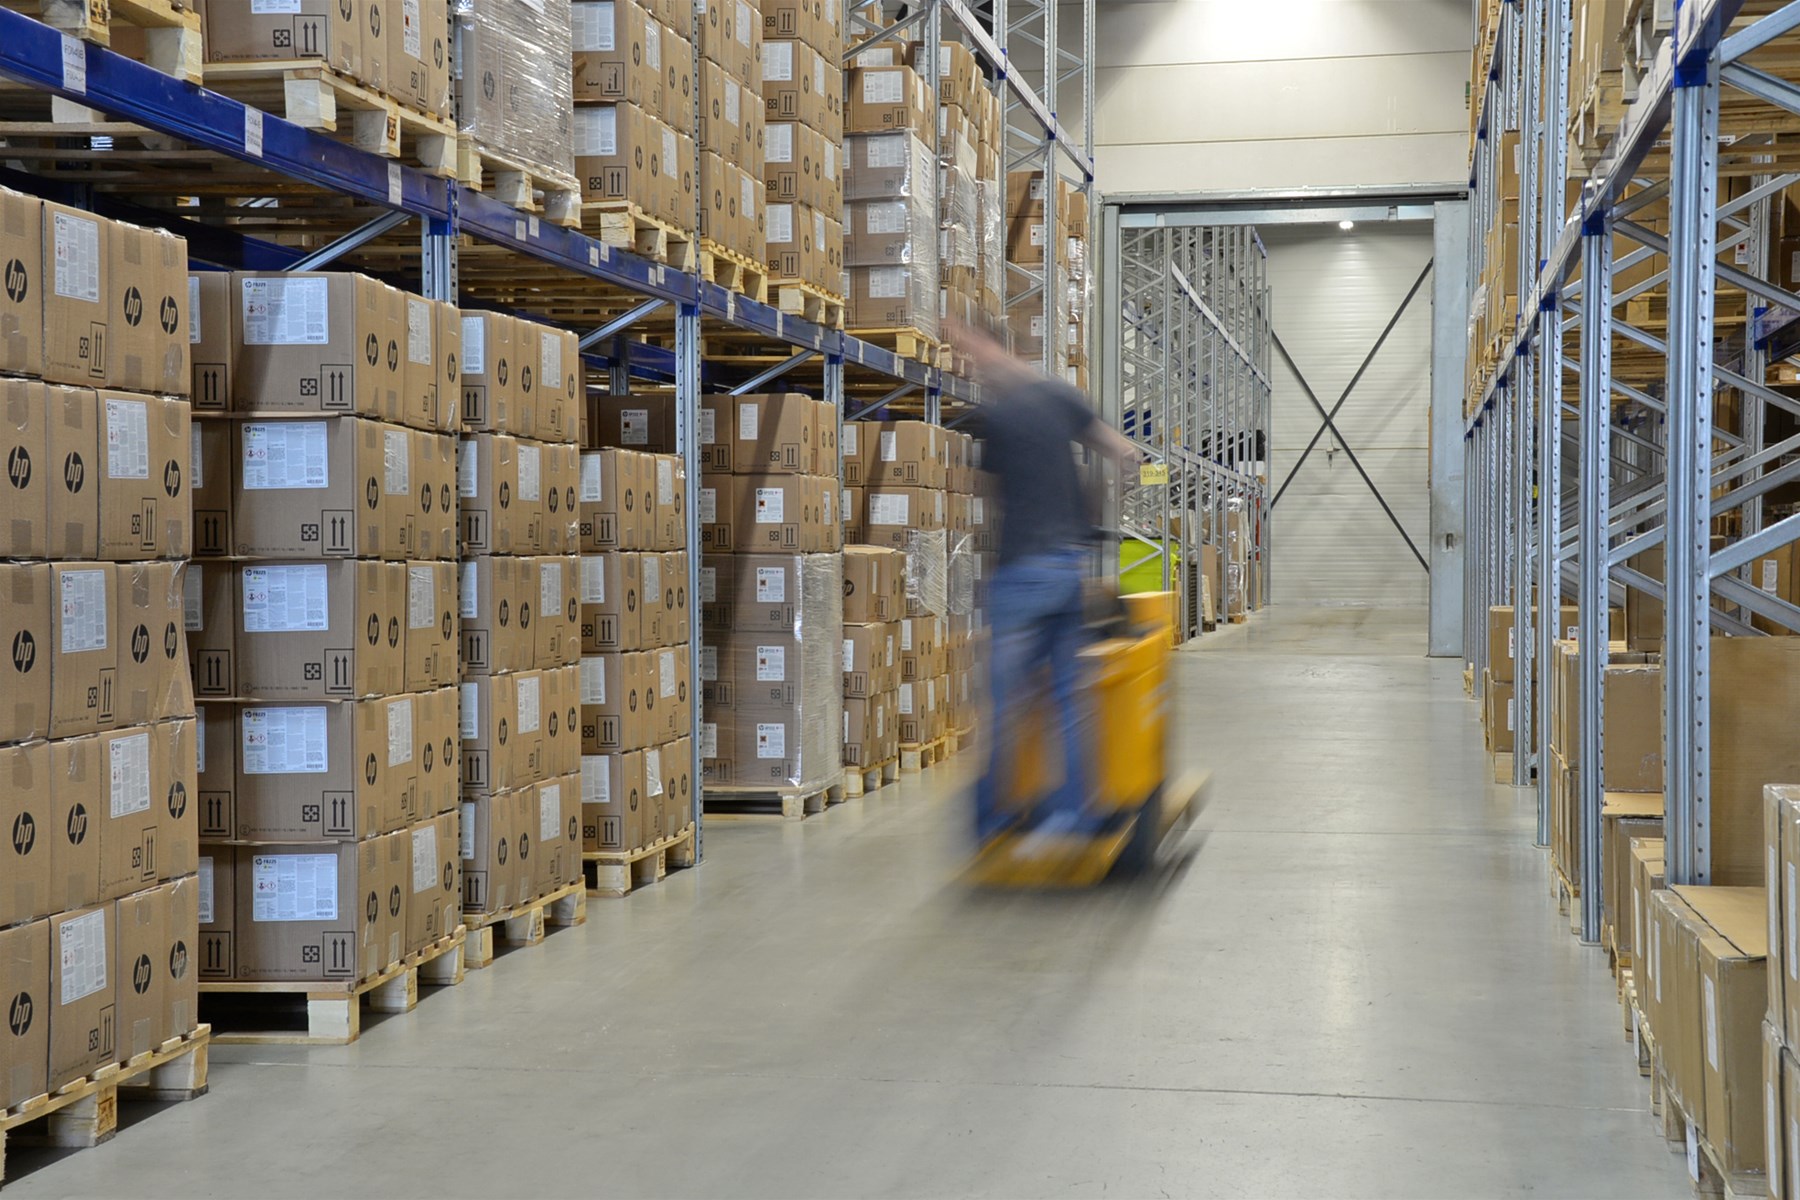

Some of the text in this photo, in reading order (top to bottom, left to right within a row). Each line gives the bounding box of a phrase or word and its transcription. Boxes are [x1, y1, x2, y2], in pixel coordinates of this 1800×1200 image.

[7, 259, 25, 303] hp
[125, 287, 141, 326] hp
[161, 296, 177, 334] hp
[10, 446, 29, 489] hp
[66, 452, 82, 493] hp
[165, 460, 179, 498] hp
[15, 630, 33, 673] hp
[133, 624, 148, 663] hp
[166, 622, 176, 659] hp
[169, 781, 185, 819] hp
[15, 812, 33, 855] hp
[69, 803, 85, 845] hp
[134, 954, 150, 994] hp
[171, 941, 185, 978] hp
[11, 992, 31, 1036] hp
